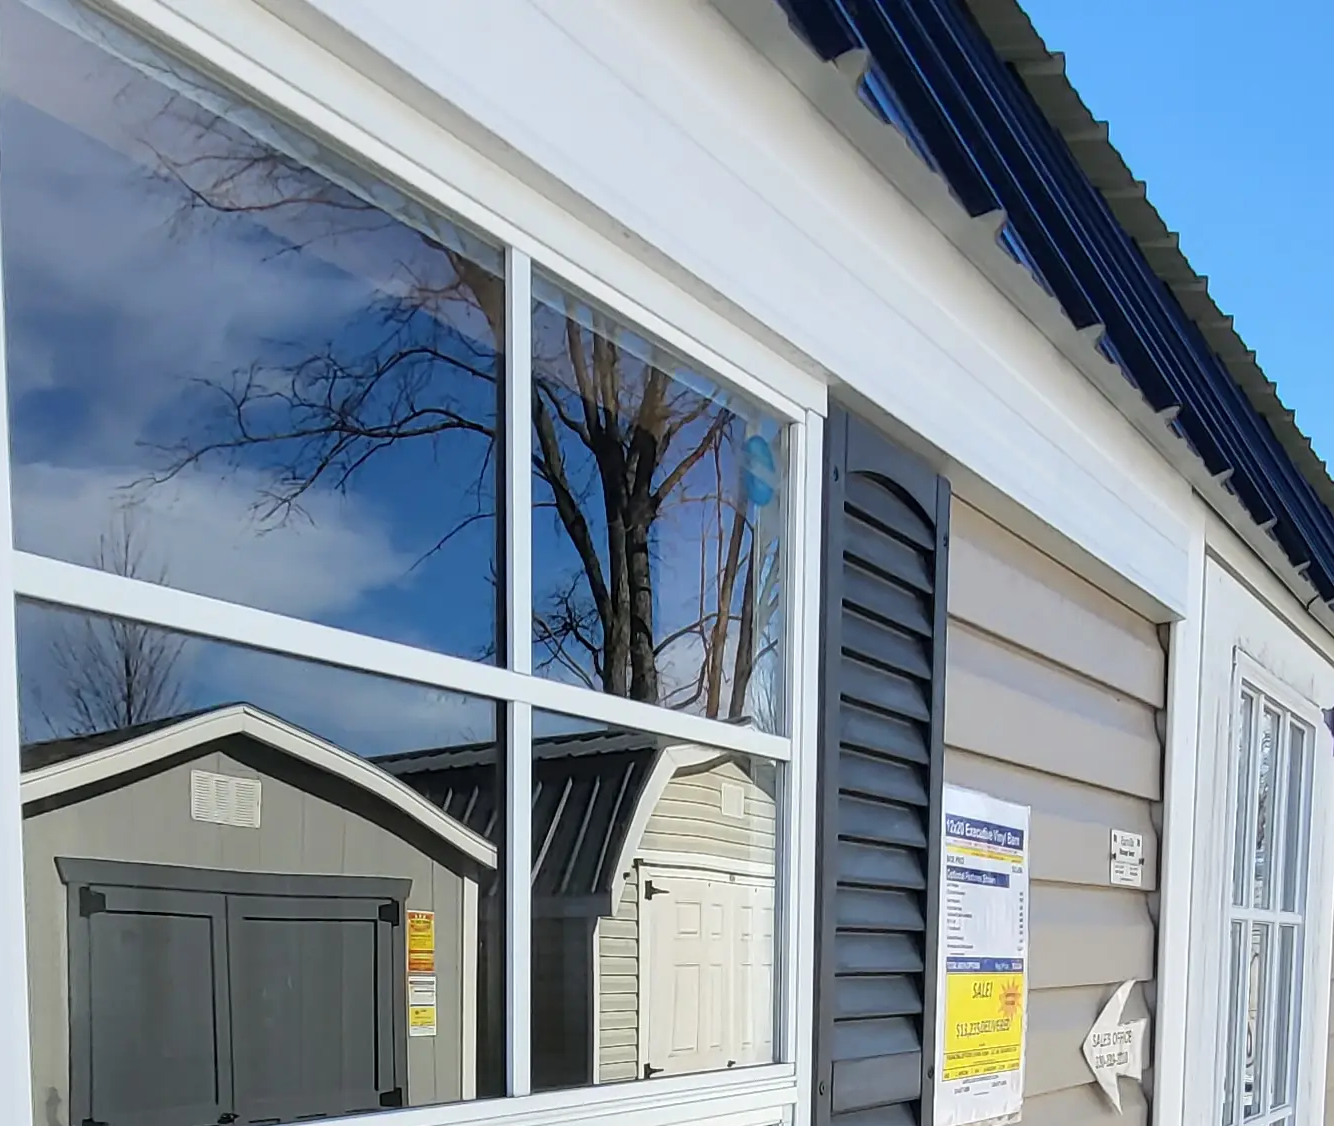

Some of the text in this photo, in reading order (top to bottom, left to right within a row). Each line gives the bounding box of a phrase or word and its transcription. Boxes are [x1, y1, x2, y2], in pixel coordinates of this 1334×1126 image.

[947, 819, 1020, 846] 12x20 Executive Vinyl Barn
[972, 981, 993, 999] SALE!
[1092, 1030, 1132, 1047] SALES OFFICE
